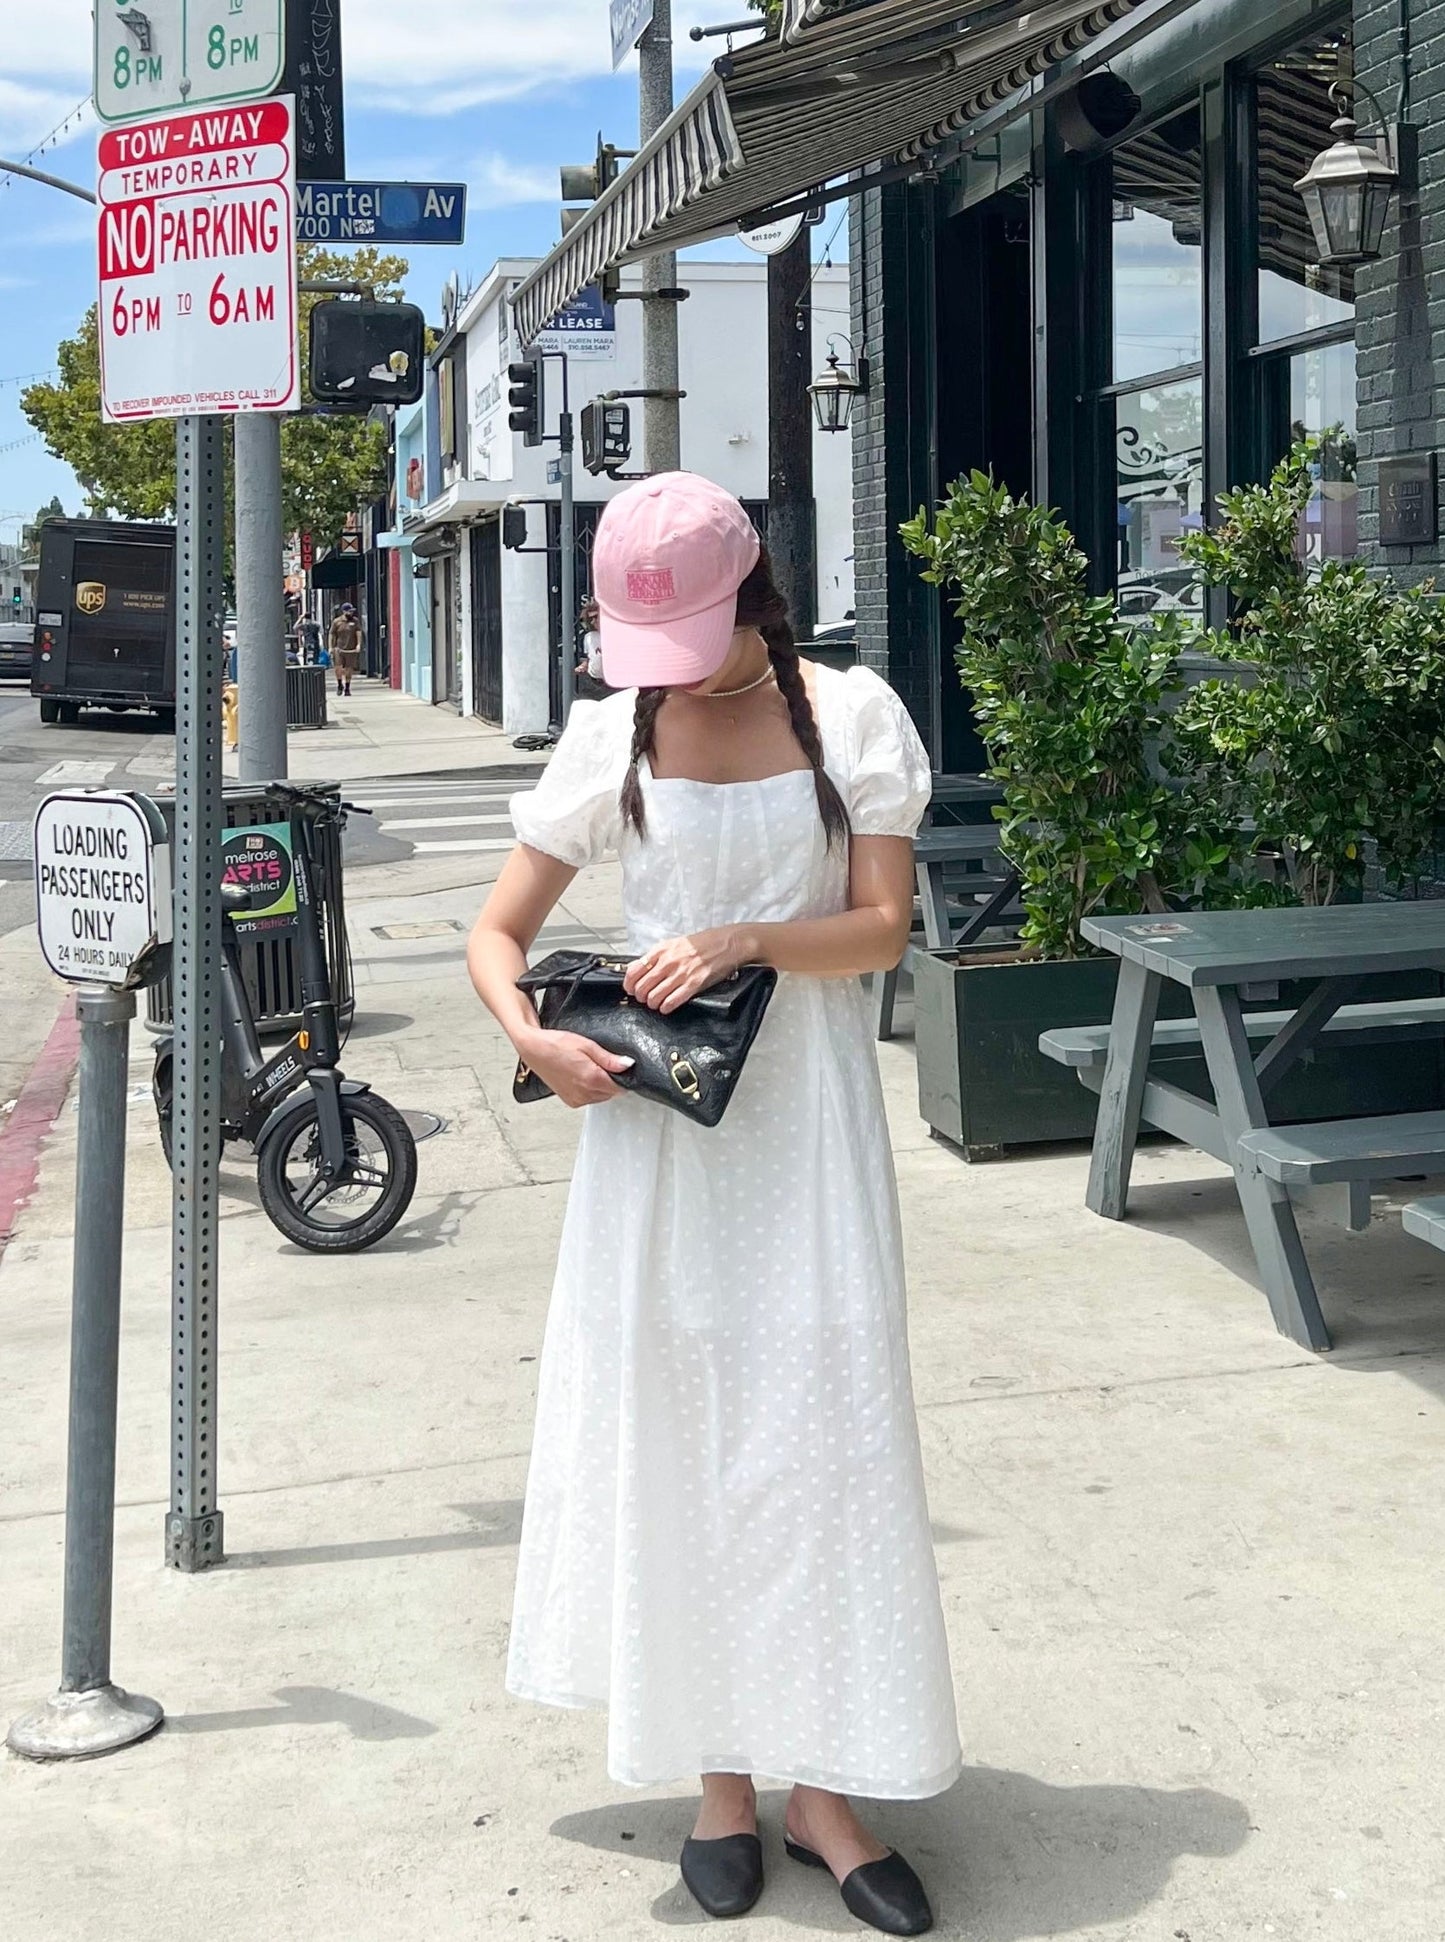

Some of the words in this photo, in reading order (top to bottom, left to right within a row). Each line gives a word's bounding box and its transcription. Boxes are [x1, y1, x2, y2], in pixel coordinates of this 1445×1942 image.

[207, 24, 258, 70] 8PM
[113, 46, 162, 89] 8PM
[116, 110, 264, 162] TOW-AWAY
[122, 152, 257, 195] TEMPORARY
[296, 185, 380, 217] Martel
[423, 188, 455, 218] Av
[106, 204, 152, 273] NO
[160, 198, 279, 264] PARKING
[112, 286, 161, 337] 6PM
[177, 293, 192, 313] TO
[209, 272, 274, 326] 6AM
[559, 317, 603, 329] LEASE
[122, 398, 149, 410] RECOVER
[152, 394, 191, 407] IMPOUNDED
[195, 391, 235, 403] VEHICLES
[238, 389, 260, 400] CALL
[264, 389, 277, 398] 311
[79, 592, 104, 609] ups
[53, 823, 128, 860] LOADING
[225, 850, 278, 865] melrose
[41, 864, 145, 904] PASSENGERS
[222, 860, 282, 884] ARTS
[72, 908, 115, 942] ONLY
[58, 945, 70, 961] 24
[74, 947, 105, 967] HOURS
[109, 951, 135, 968] DAILY
[265, 1055, 296, 1088] WHEELS
